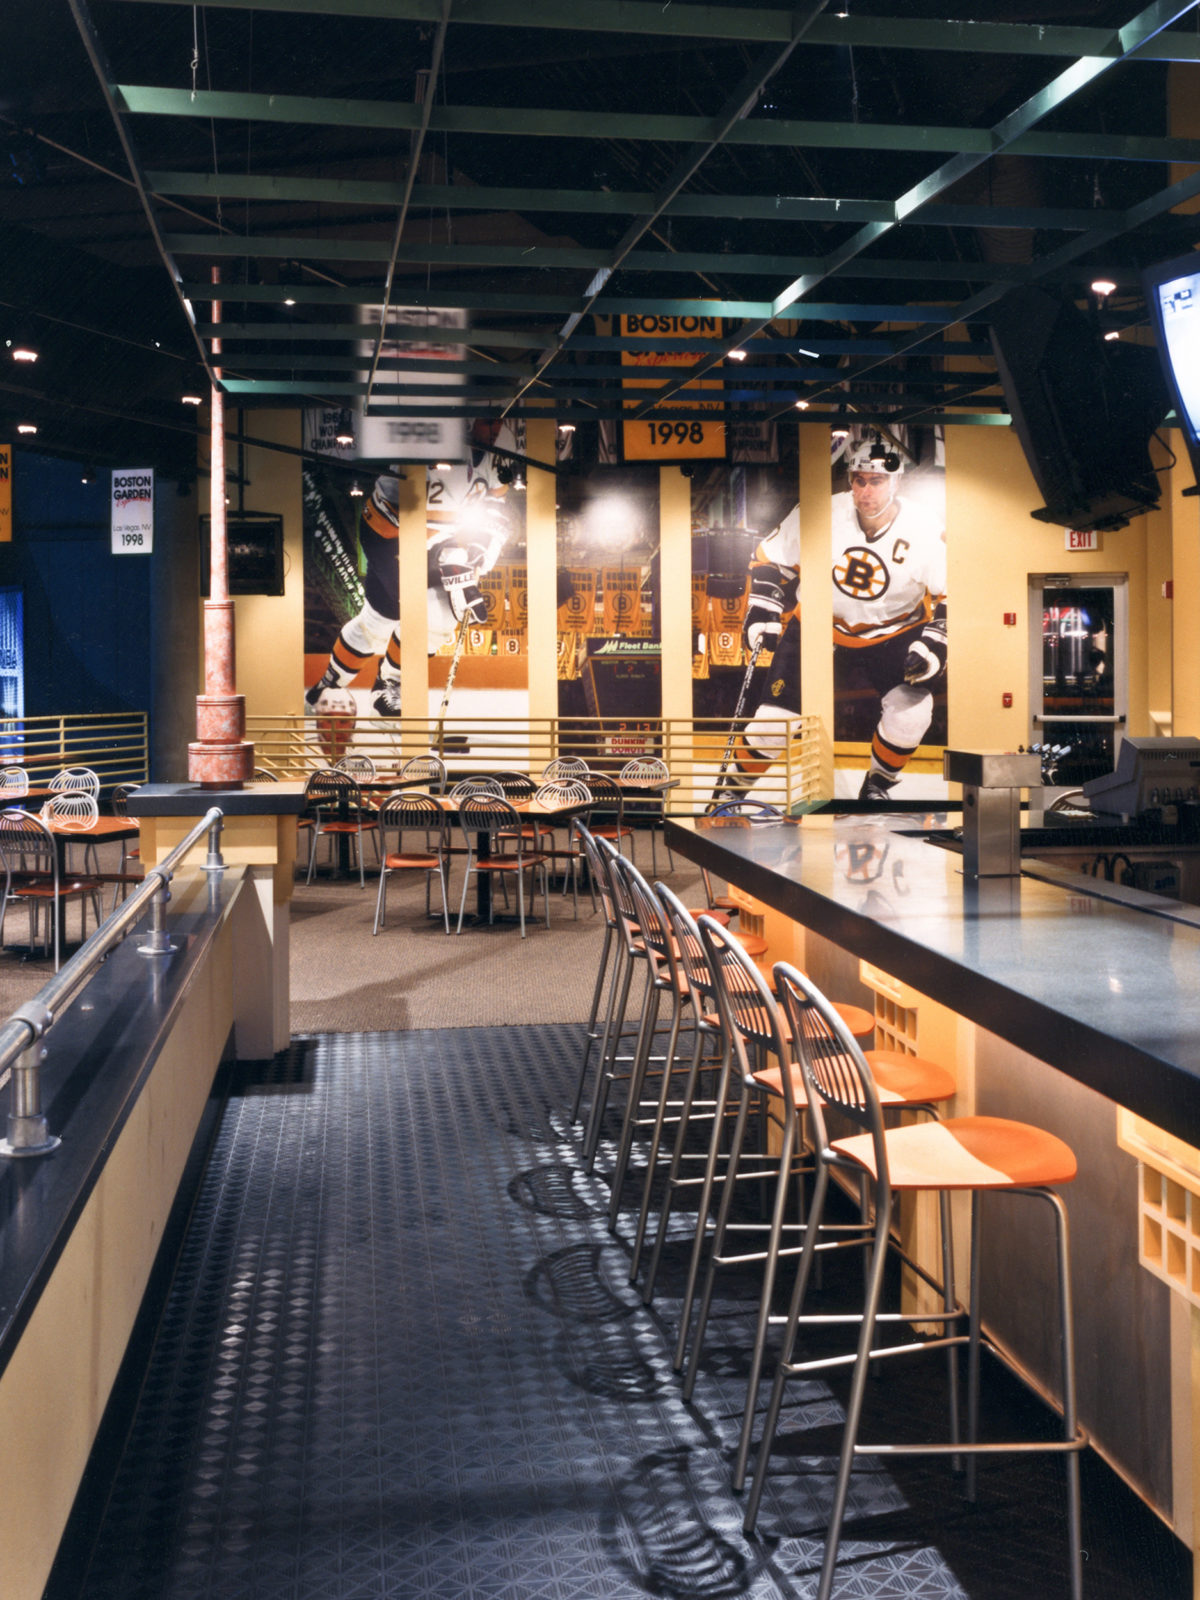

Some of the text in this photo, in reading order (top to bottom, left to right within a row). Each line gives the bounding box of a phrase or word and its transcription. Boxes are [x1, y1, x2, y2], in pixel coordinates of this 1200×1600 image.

[626, 315, 715, 332] BOSTON
[648, 422, 704, 445] 1998
[114, 476, 151, 488] BOSTON
[114, 489, 151, 500] GARDEN
[121, 534, 144, 546] 1998
[1070, 530, 1093, 548] EXIT
[892, 538, 910, 565] C
[845, 557, 875, 591] B
[618, 641, 641, 650] Fleet
